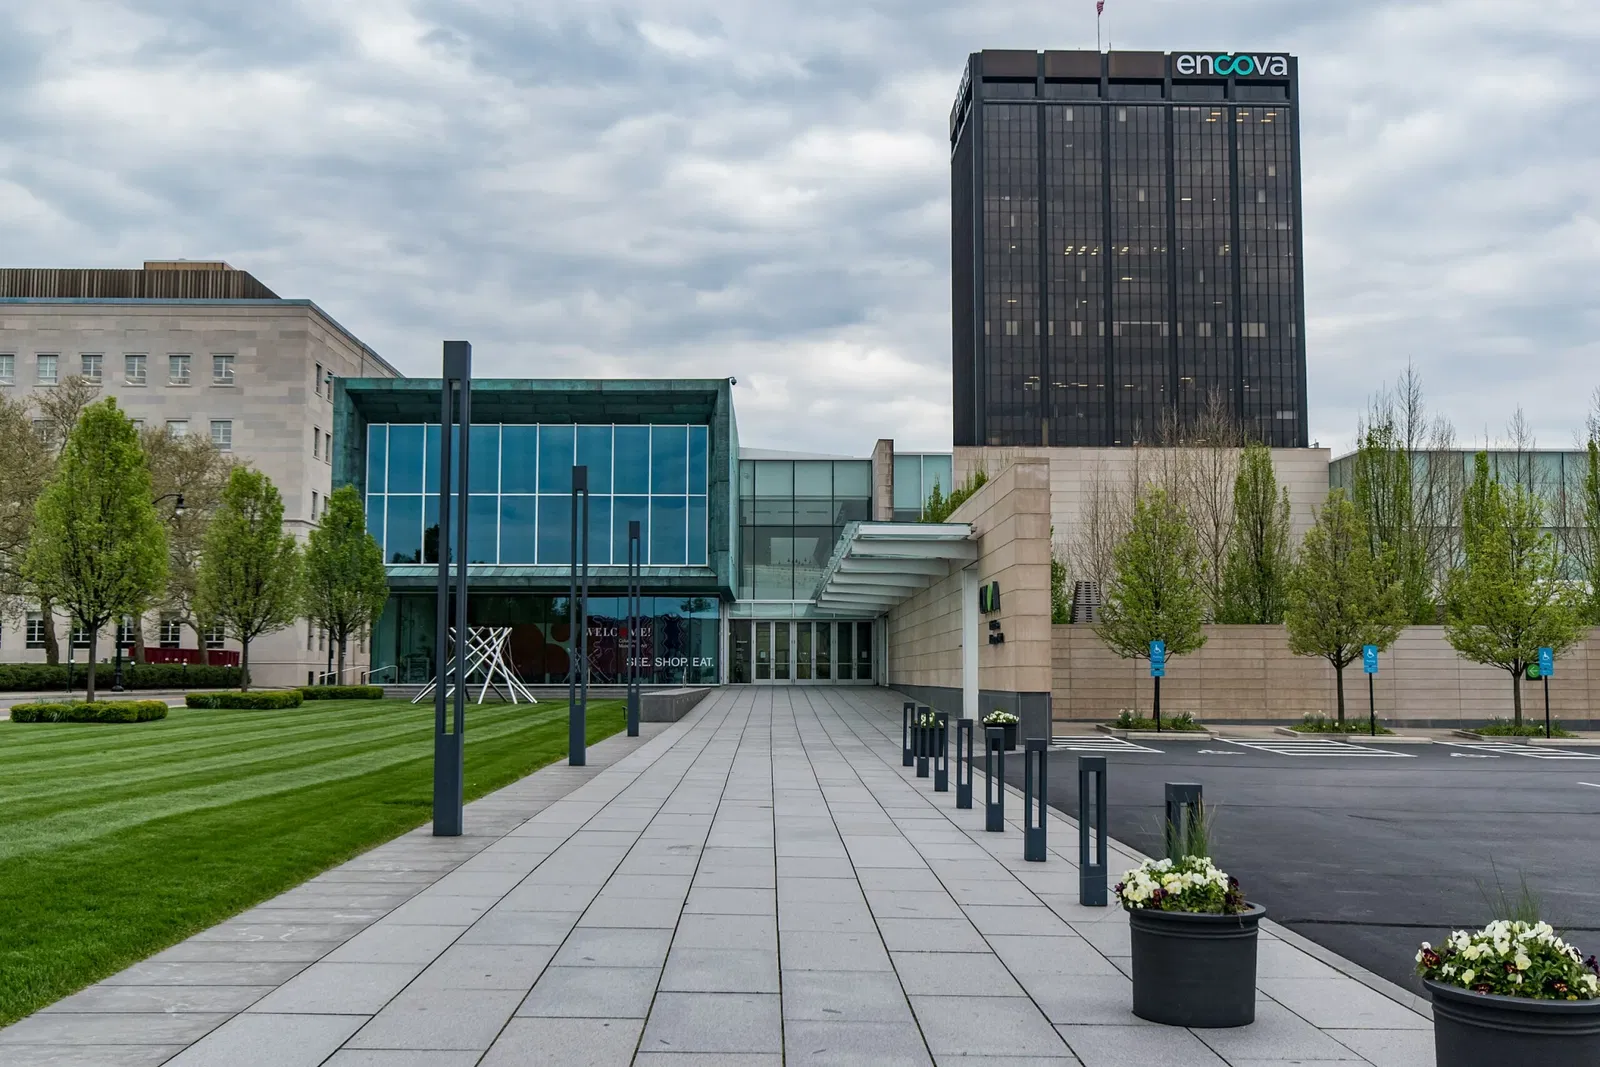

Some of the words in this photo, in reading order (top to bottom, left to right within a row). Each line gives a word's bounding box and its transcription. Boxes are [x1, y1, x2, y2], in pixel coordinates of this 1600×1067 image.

[1177, 54, 1287, 76] encova
[655, 657, 689, 667] SHOP.
[692, 657, 714, 667] EAT.
